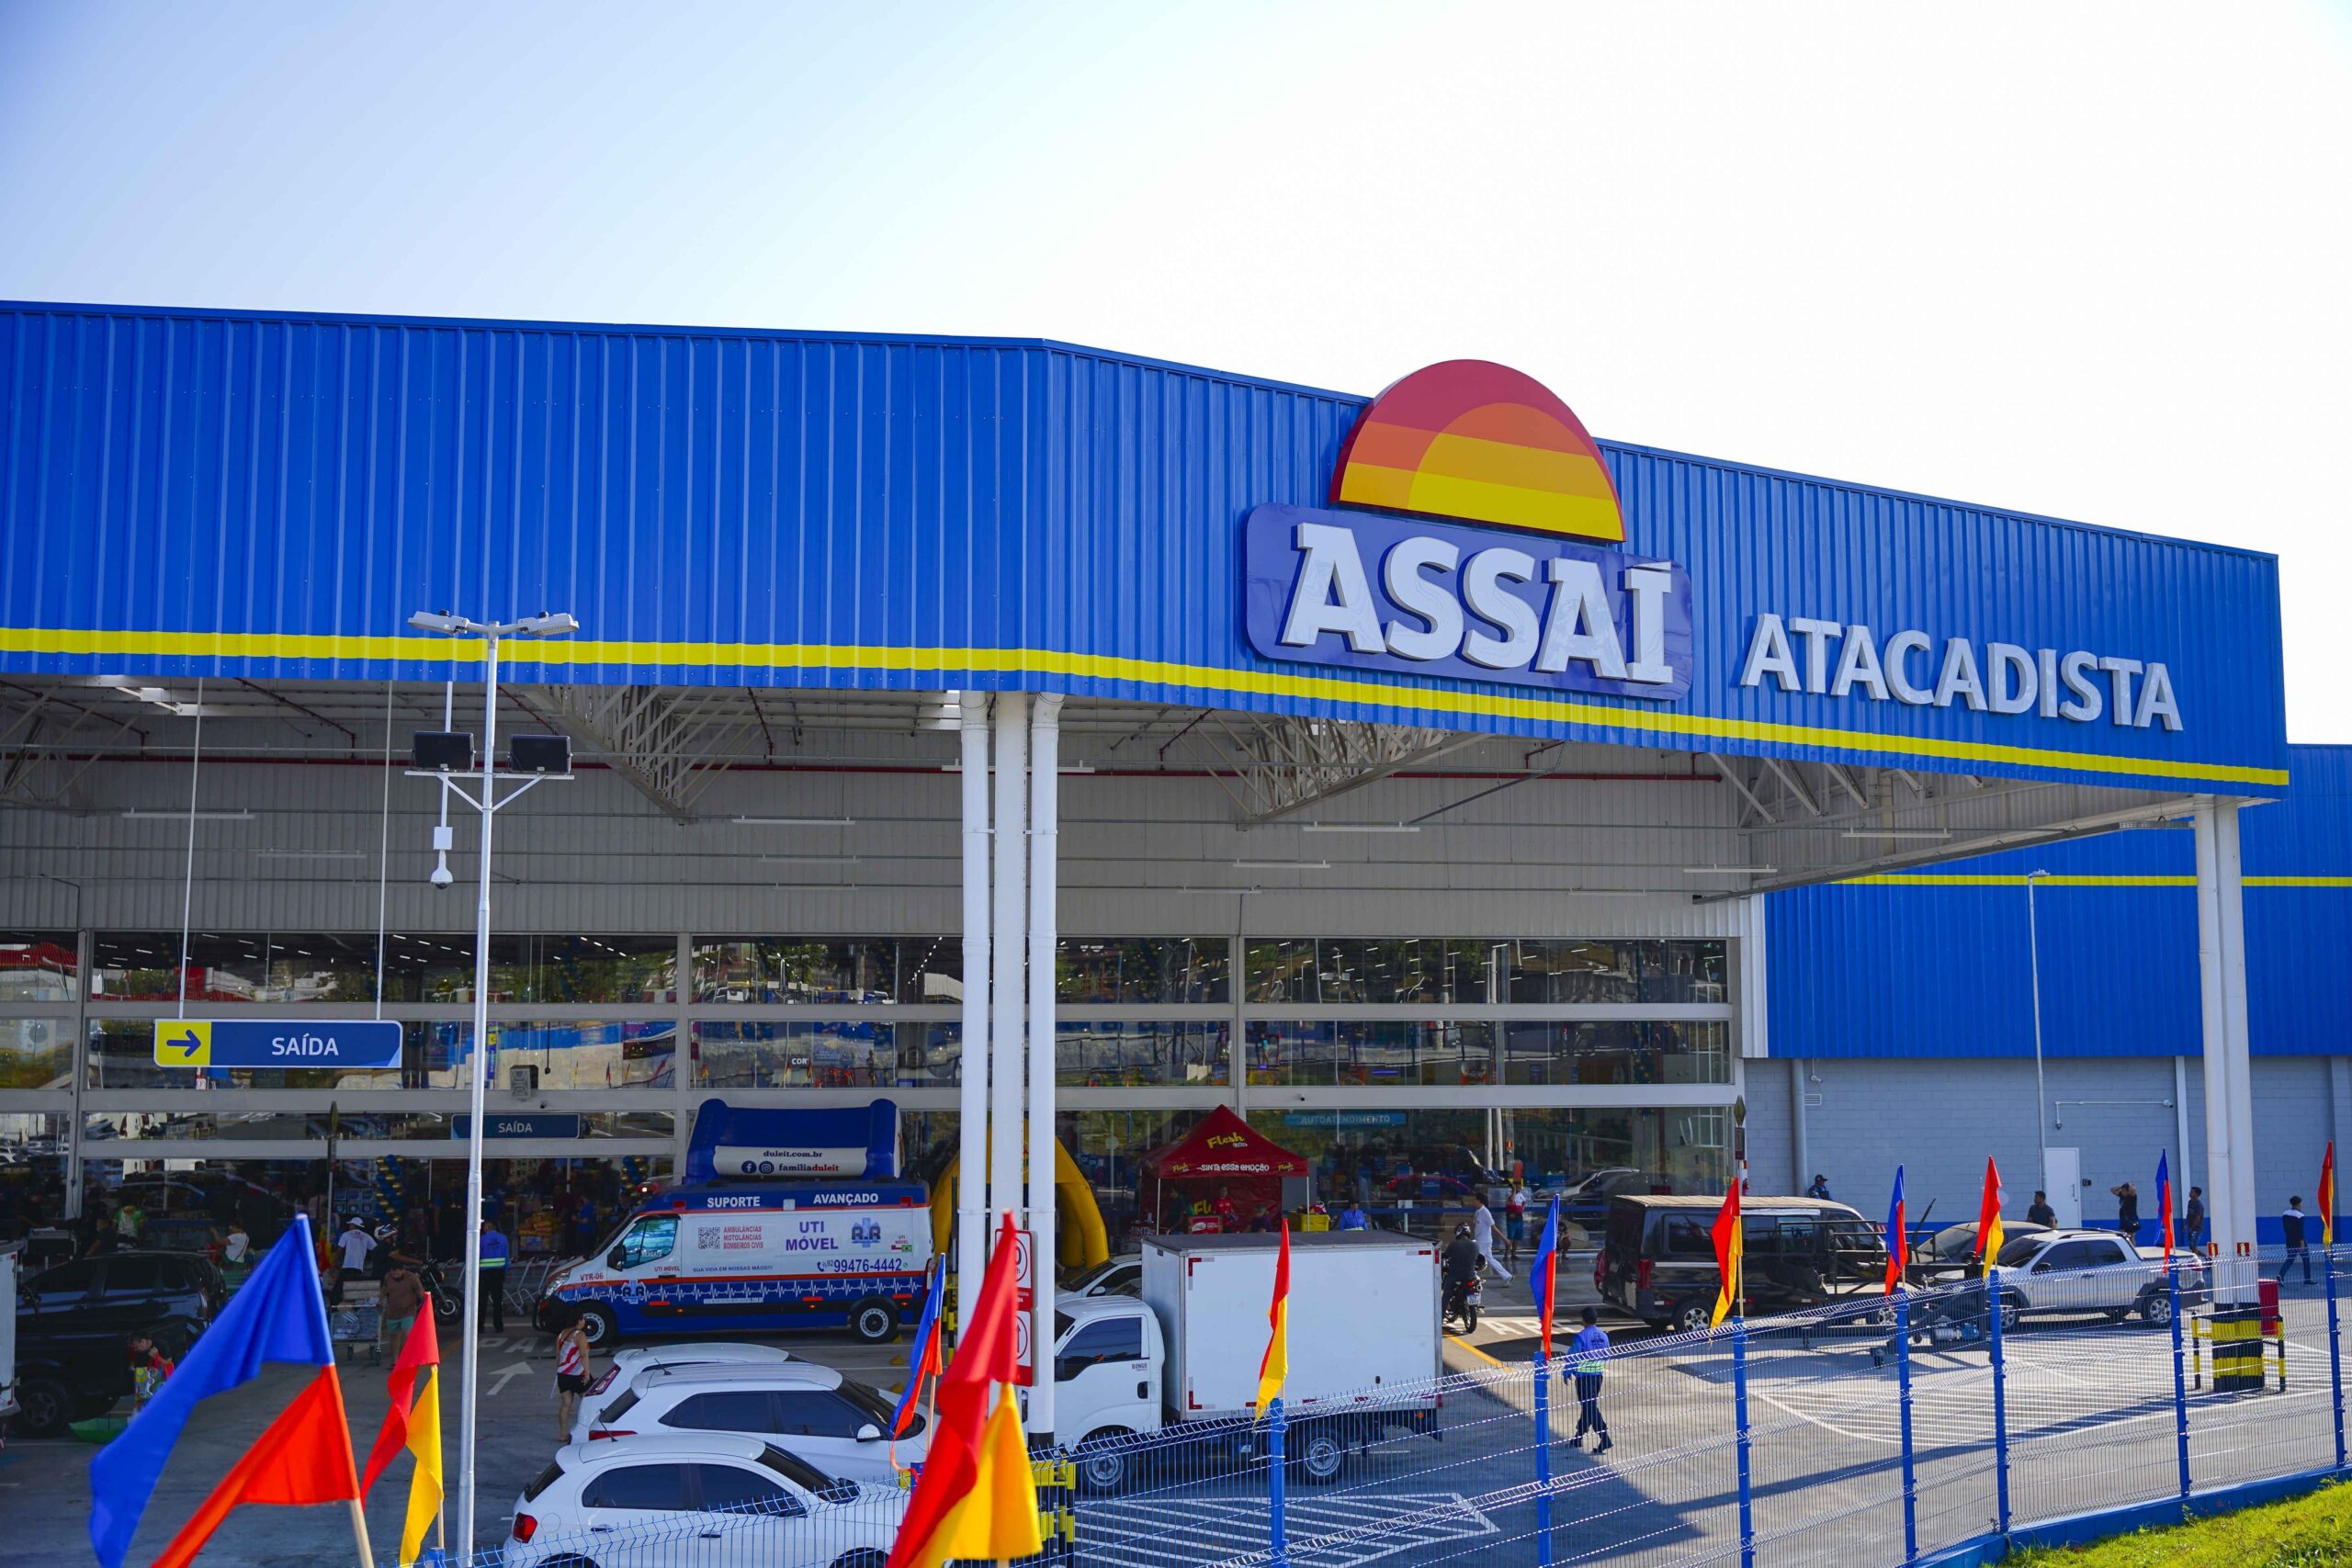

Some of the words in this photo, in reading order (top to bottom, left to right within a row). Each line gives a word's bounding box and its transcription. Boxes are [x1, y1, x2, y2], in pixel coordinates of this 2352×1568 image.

[1280, 522, 1674, 684] ASSAÍ
[1739, 613, 2185, 732] ATACADISTA
[271, 1032, 340, 1056] SAÍDA
[1300, 1114, 1390, 1124] AUTOATENDIMENTO
[498, 1120, 533, 1133] SAÍDA
[763, 1150, 823, 1158] duleit.com.br
[778, 1163, 839, 1173] familiaduleit
[707, 1196, 761, 1208] SUPORTE
[813, 1193, 879, 1206] AVANÇADO
[723, 1224, 763, 1233] AMBULÂNCIAS
[799, 1221, 824, 1234] UTI
[751, 1241, 764, 1249] CIVIS
[786, 1235, 839, 1251] MÓVEL
[833, 1258, 902, 1272] 99476-4442
[580, 1272, 604, 1280] VTR-06
